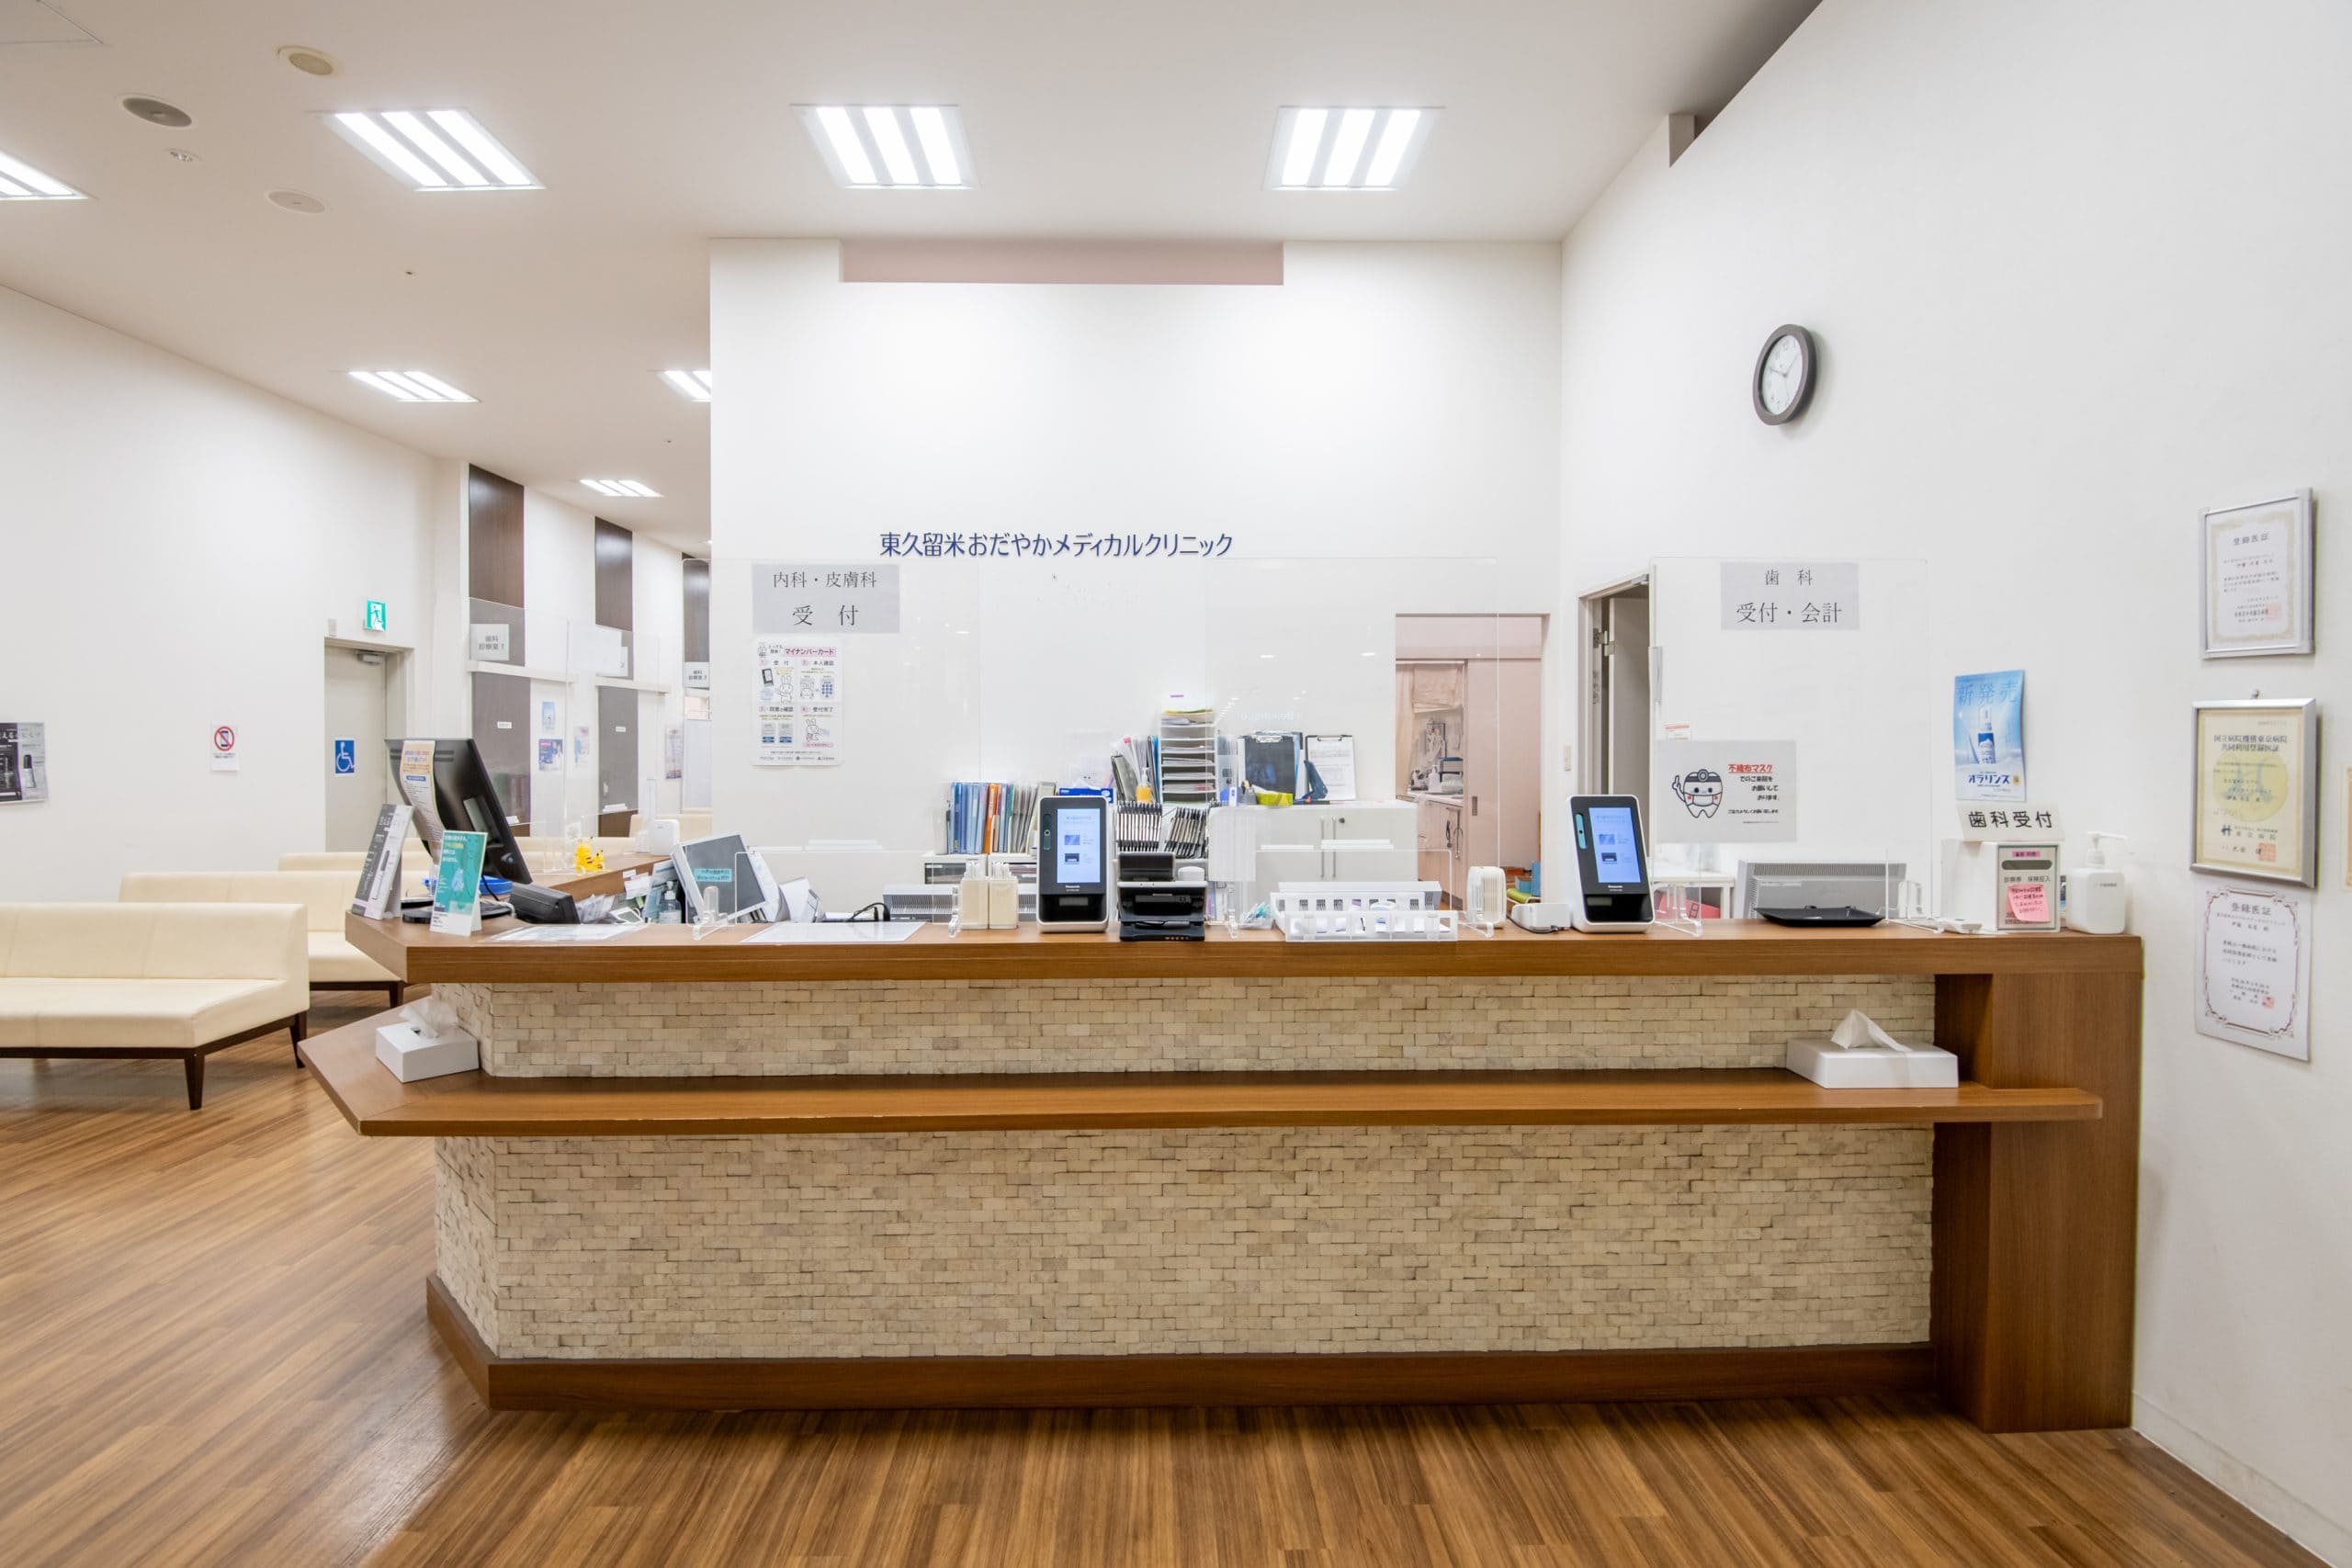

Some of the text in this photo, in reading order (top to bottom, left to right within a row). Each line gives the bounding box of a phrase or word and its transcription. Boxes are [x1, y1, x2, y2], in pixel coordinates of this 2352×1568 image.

[879, 531, 1233, 558] 東久留米おだやかメディカルクリニック
[773, 571, 877, 589] 内科・皮膚科
[1765, 569, 1814, 586] 歯科
[792, 604, 859, 626] 受付
[1736, 602, 1843, 624] 受付・会計
[785, 648, 834, 656] マイナンバーカード
[1958, 682, 2018, 705] 新発売
[1728, 763, 1773, 773] 不織布マスク
[1968, 774, 2010, 784] オラリンス
[1968, 810, 2053, 829] 歯科受付
